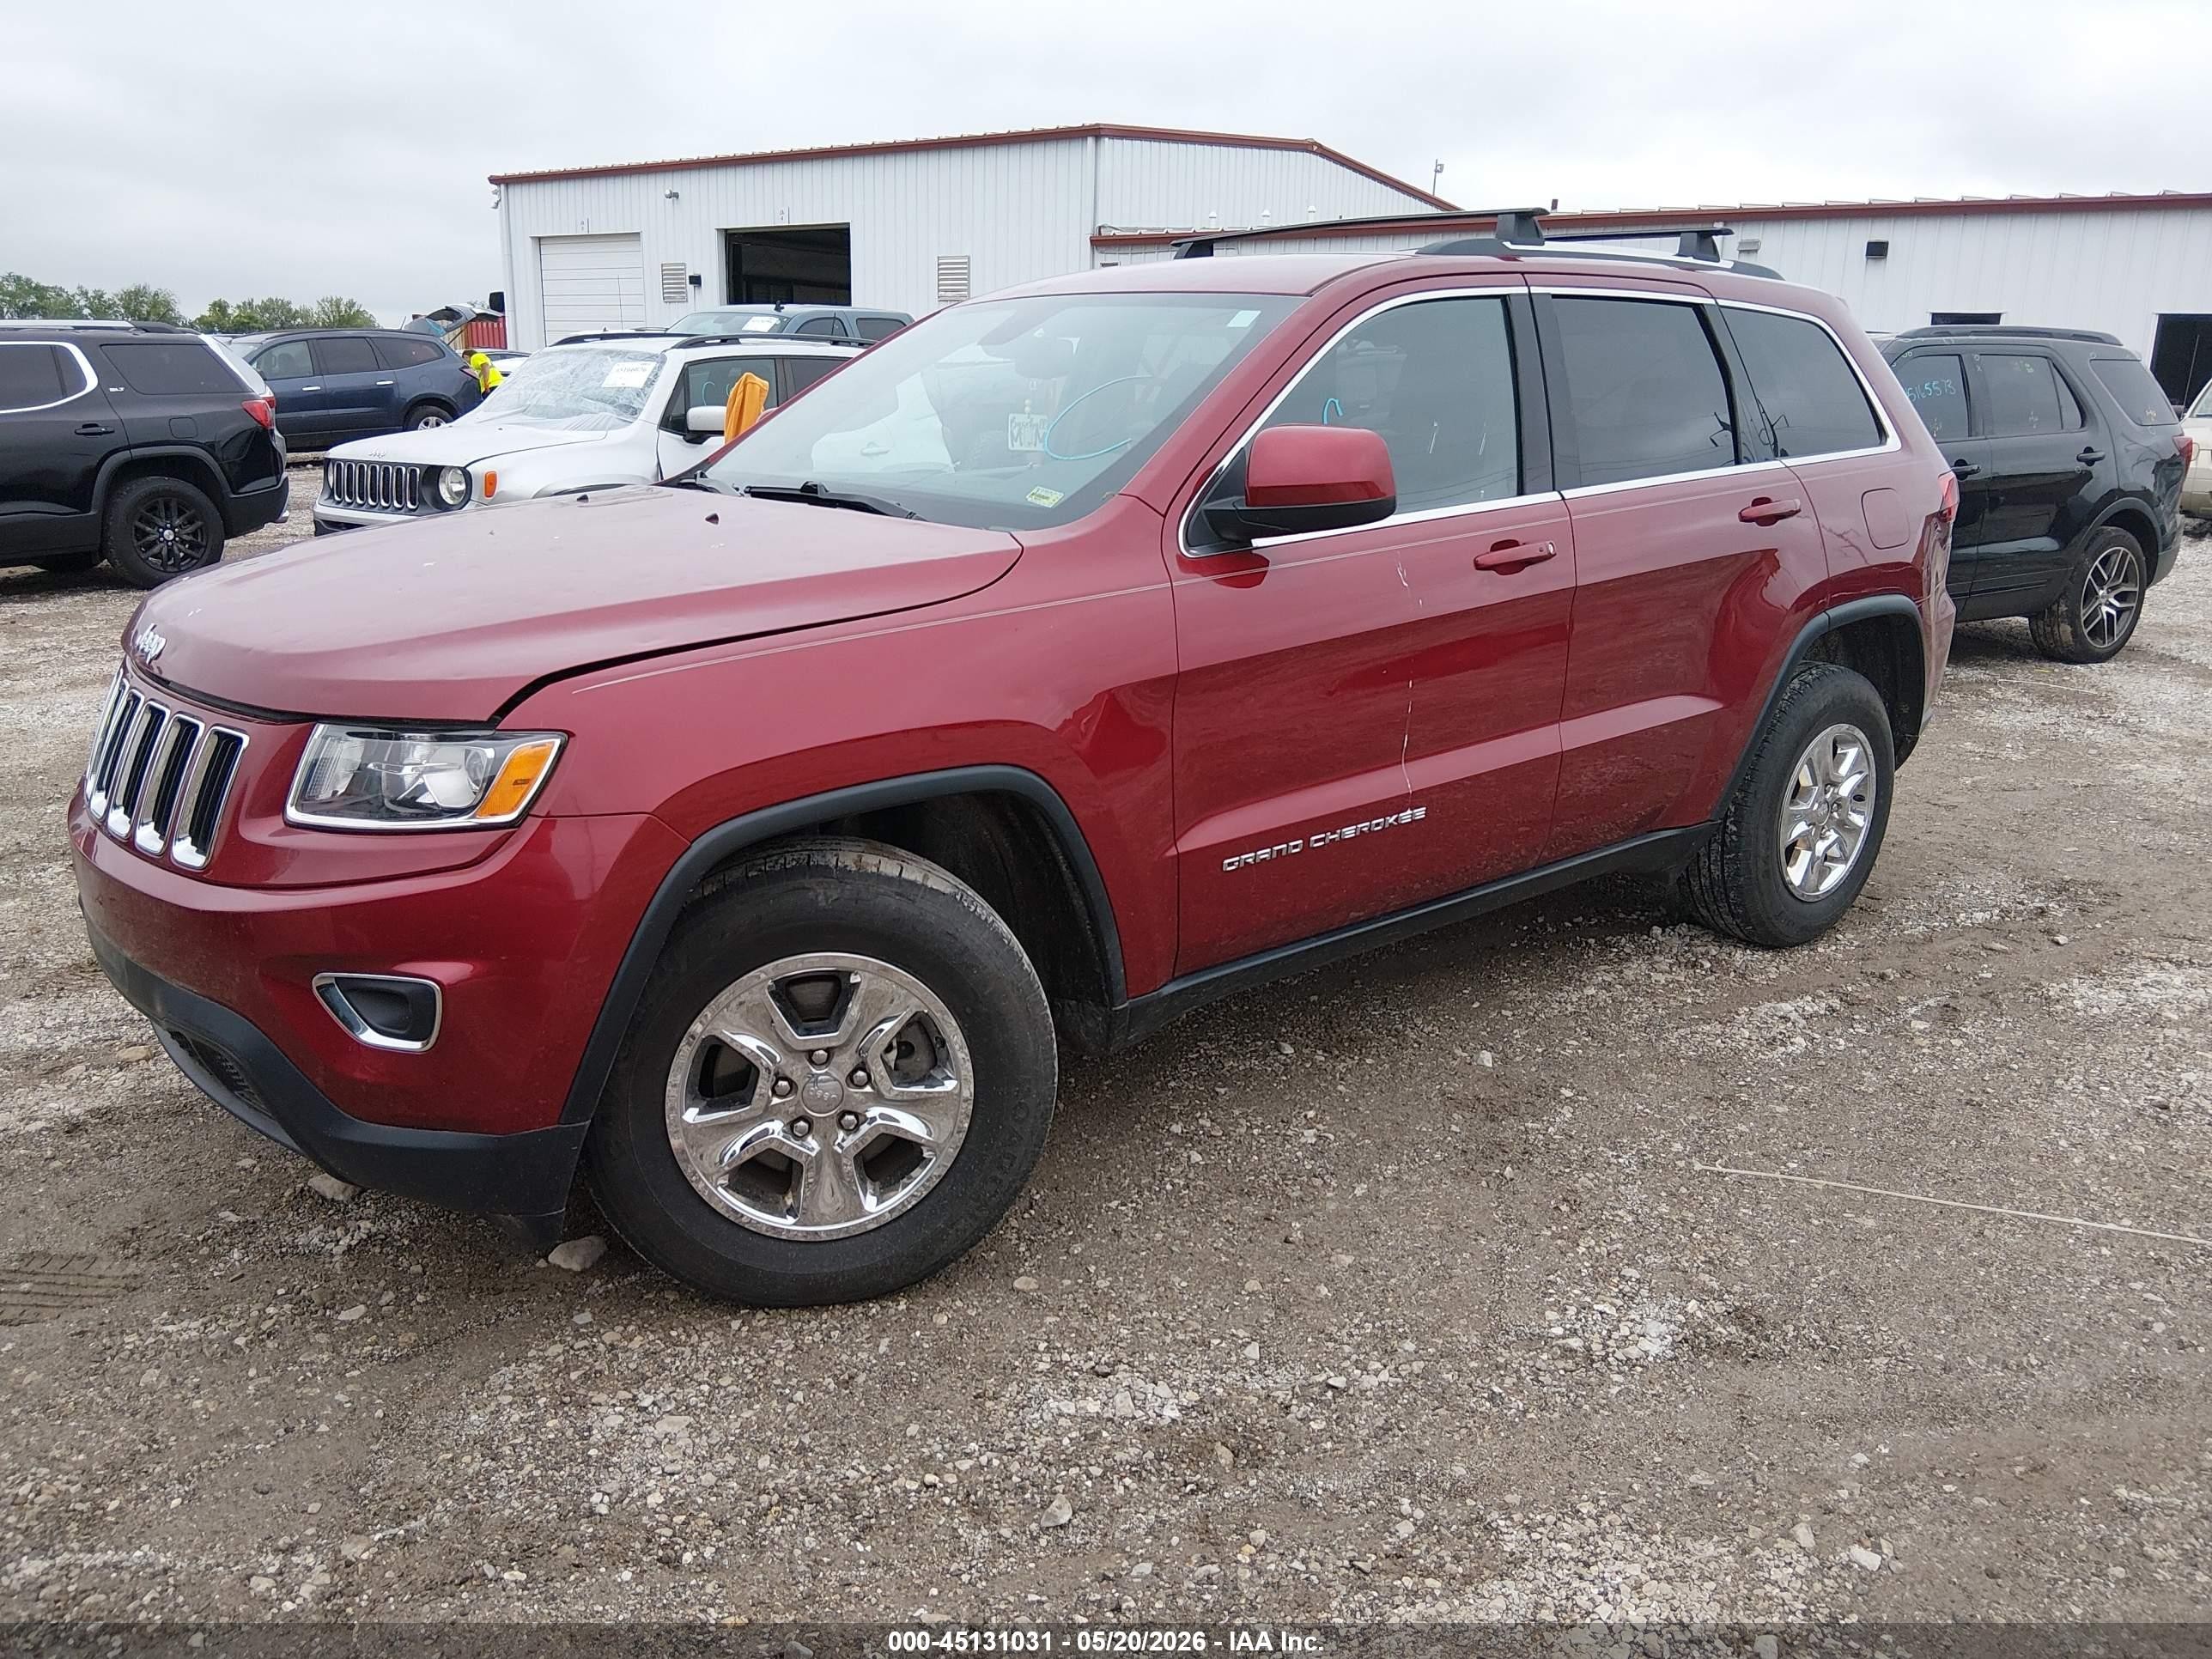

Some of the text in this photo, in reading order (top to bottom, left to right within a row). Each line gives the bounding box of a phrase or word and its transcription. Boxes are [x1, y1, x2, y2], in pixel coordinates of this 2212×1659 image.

[1905, 379, 1956, 402] 5165573
[1222, 807, 1426, 872] GRAND CHEROKEE
